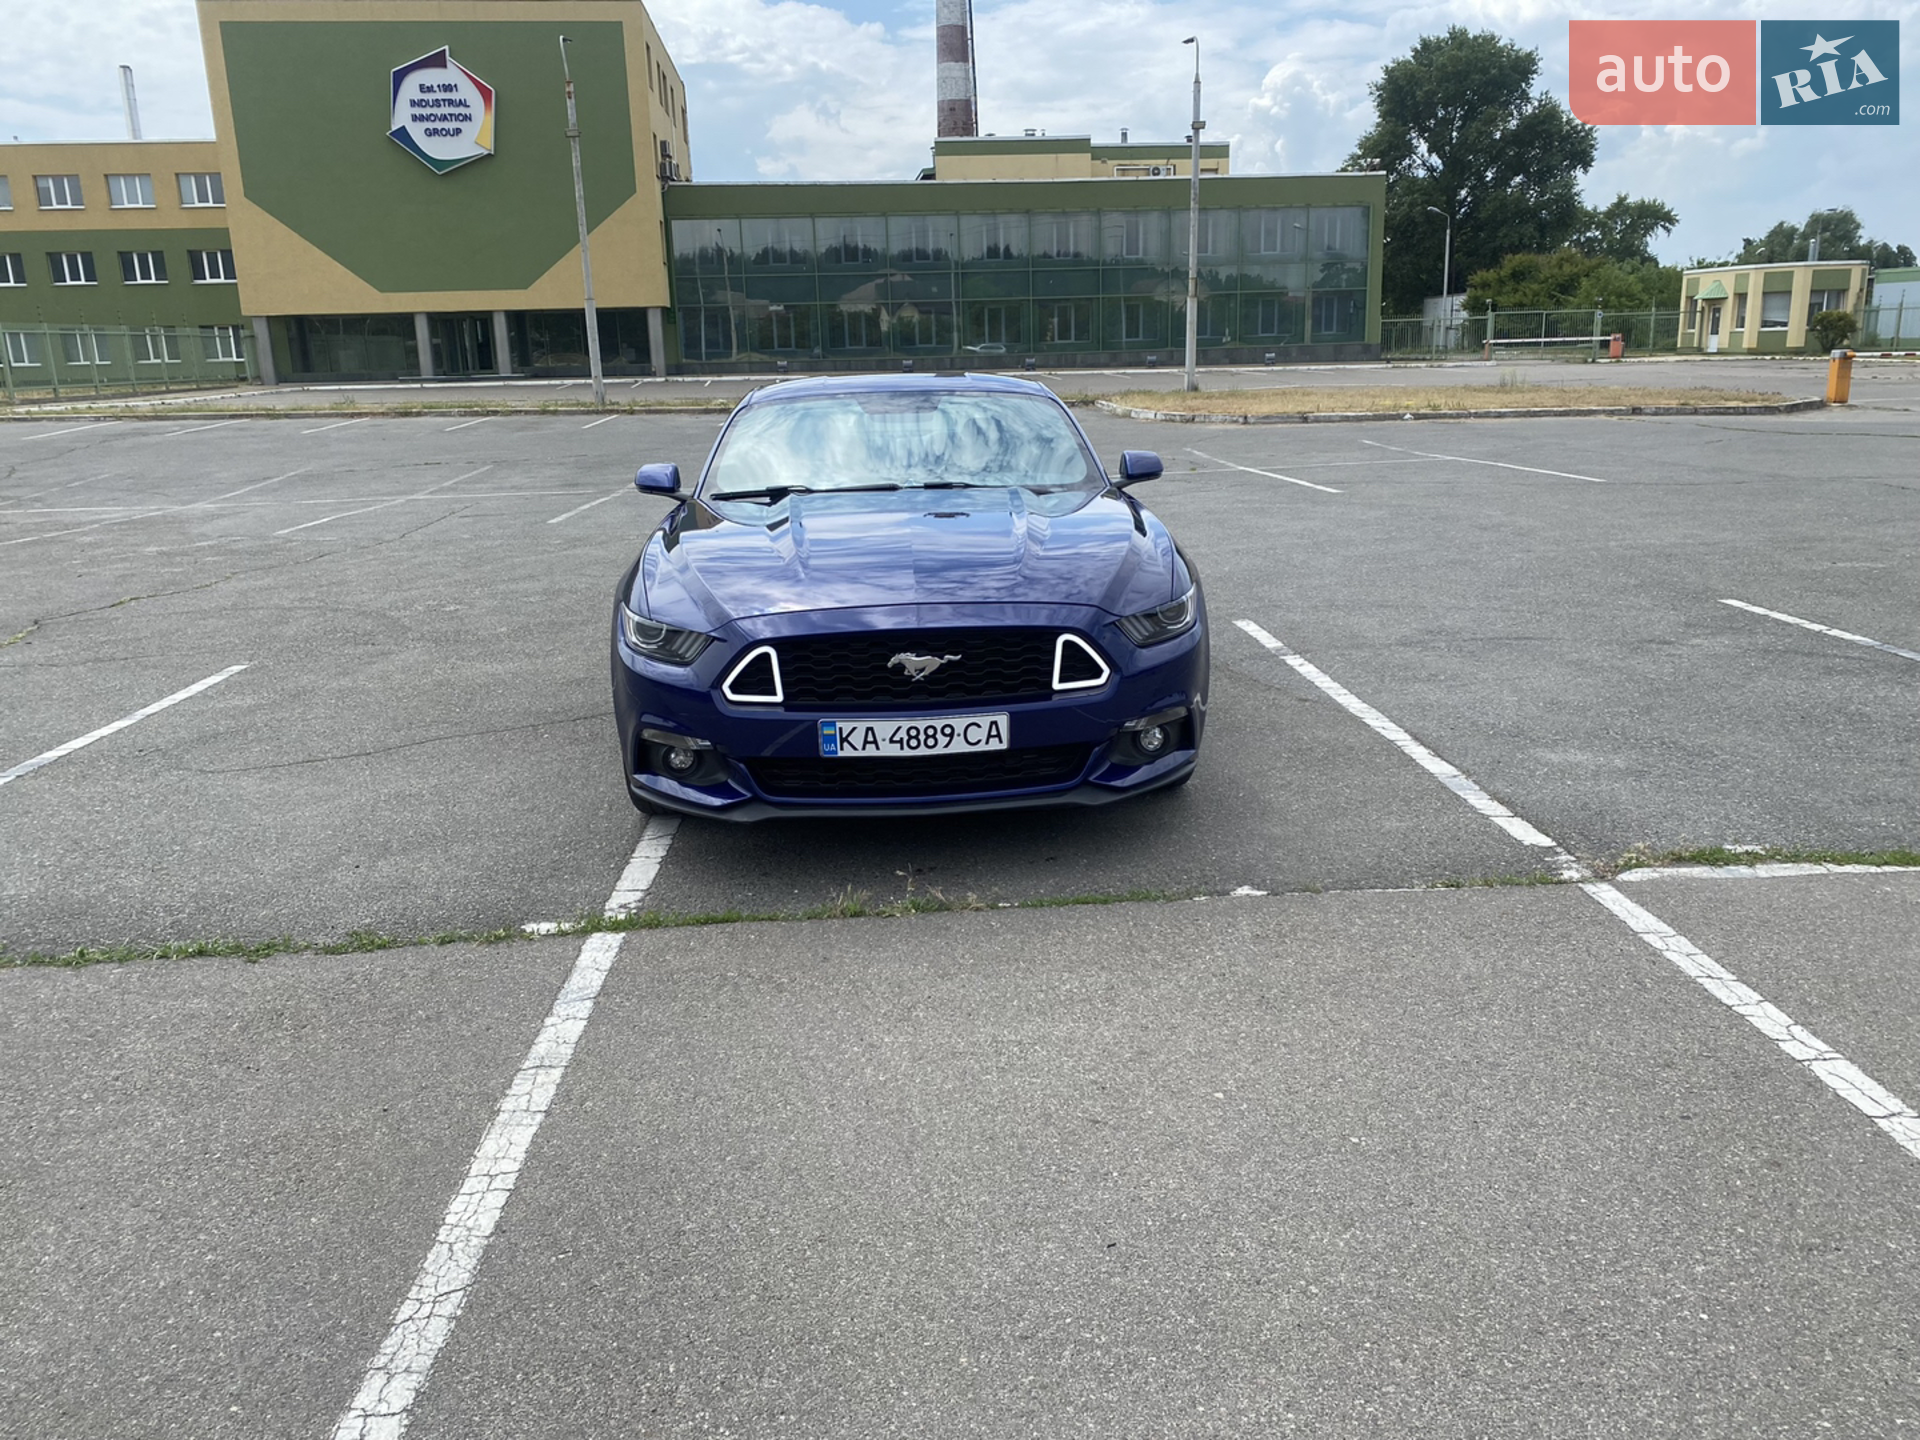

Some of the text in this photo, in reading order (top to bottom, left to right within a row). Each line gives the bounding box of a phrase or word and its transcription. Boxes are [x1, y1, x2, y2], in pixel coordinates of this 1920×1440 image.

[409, 98, 471, 109] INDUSTRIAL
[411, 112, 473, 123] INNOVATION
[424, 127, 463, 138] GROUP
[823, 743, 837, 752] UA
